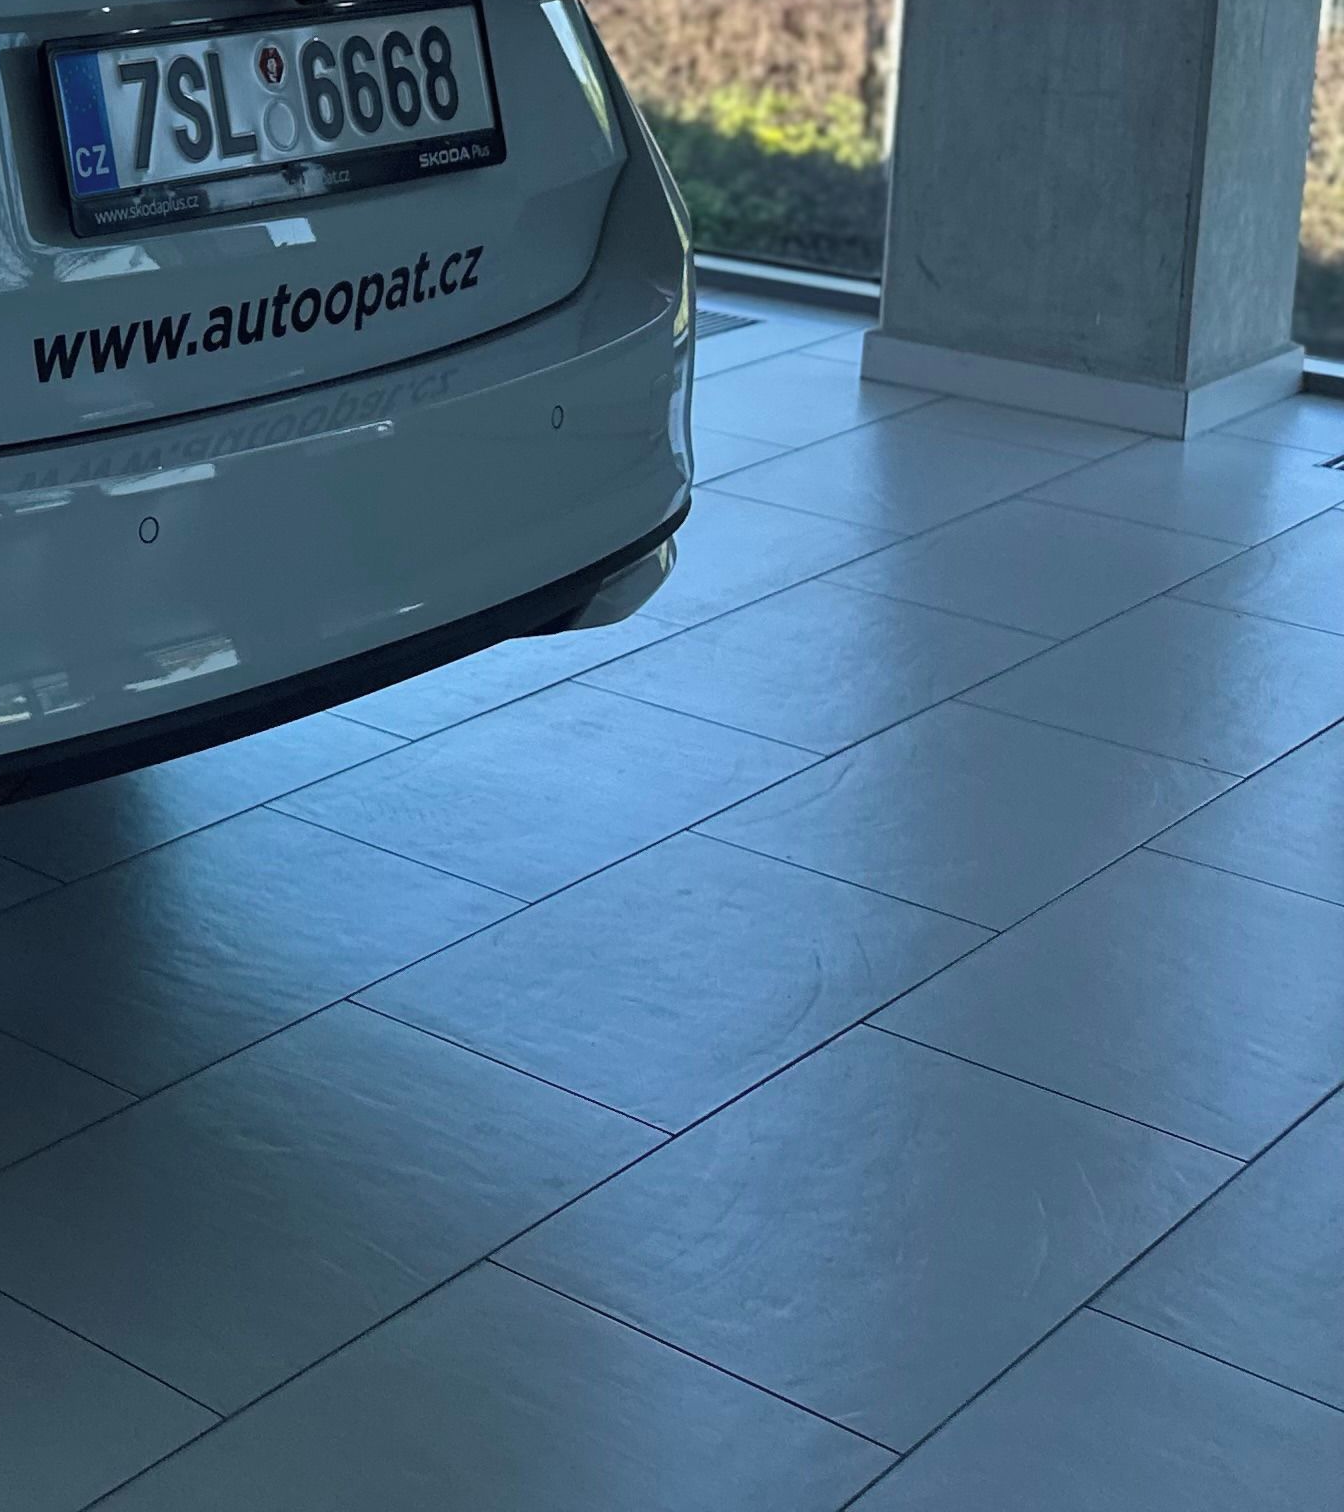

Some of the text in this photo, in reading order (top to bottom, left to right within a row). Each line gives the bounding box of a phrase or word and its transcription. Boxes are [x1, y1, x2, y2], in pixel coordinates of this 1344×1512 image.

[117, 24, 460, 172] 7SL 6668
[75, 143, 111, 179] CZ
[472, 143, 491, 160] Plus
[94, 193, 200, 226] www.skodaplus.cz
[32, 244, 485, 384] www.autoopat.cz
